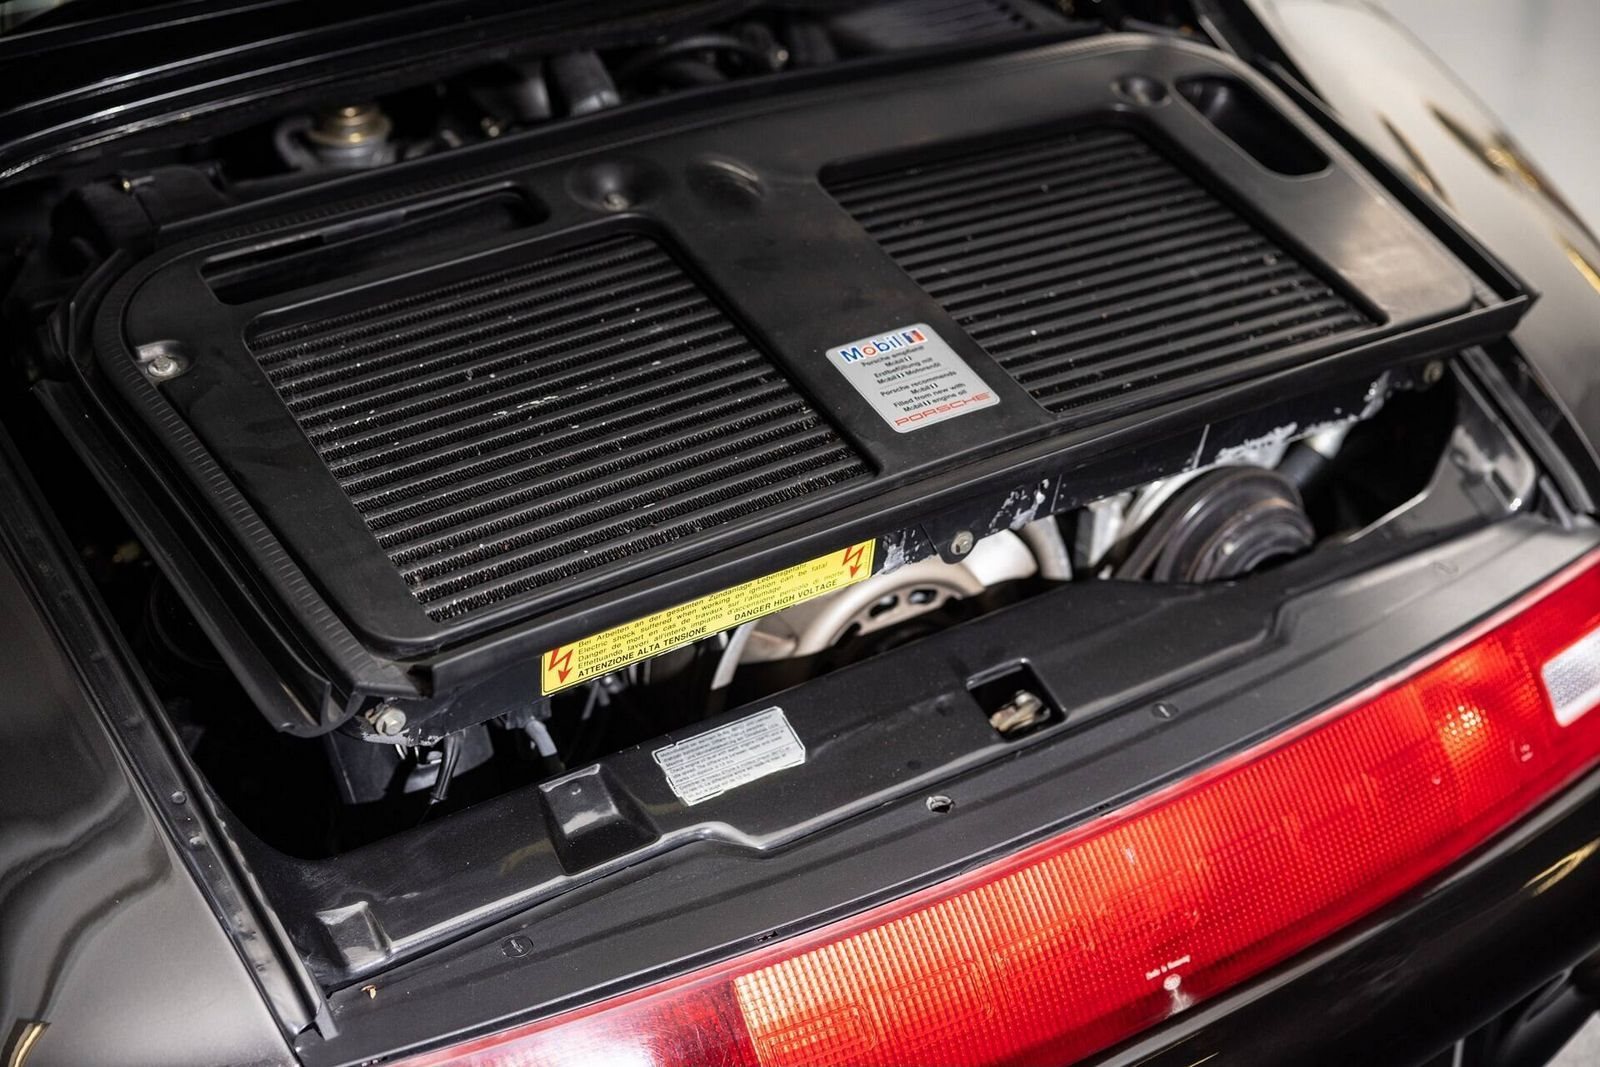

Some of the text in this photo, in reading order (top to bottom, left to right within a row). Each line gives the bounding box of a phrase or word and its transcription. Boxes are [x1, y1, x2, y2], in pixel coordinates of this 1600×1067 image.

[840, 336, 902, 362] Mobil
[861, 356, 890, 367] Porsche
[885, 358, 904, 367] Mobil
[877, 375, 897, 384] Mobil
[880, 371, 957, 397] Porsche recommends
[910, 385, 931, 394] Mobil
[893, 398, 914, 407] Filled
[914, 393, 932, 401] from
[894, 393, 990, 426] PORSCHE
[903, 403, 923, 412] Mobil
[932, 393, 957, 403] engine
[578, 641, 607, 655] Electric
[613, 631, 635, 643] shock
[640, 617, 672, 633] suffered
[676, 609, 696, 620] when
[701, 597, 730, 611] working
[749, 581, 775, 594] ignition
[780, 575, 793, 583] can
[811, 562, 827, 571] fatal
[578, 640, 591, 648] Bei
[596, 626, 629, 641] Arbeiten
[648, 614, 662, 623] der
[666, 600, 703, 618] gesamten
[578, 579, 837, 678] ATTENZIONE ALTA TENSIONE DANGER HIGH VOLTAGE
[578, 648, 606, 662] Danger
[626, 634, 644, 644] mort
[695, 607, 722, 620] travaux
[728, 600, 739, 608] sur
[578, 649, 623, 669] Effettuando
[627, 640, 648, 651] lavori
[654, 626, 686, 642] all'intero
[690, 613, 722, 628] impianto
[727, 595, 774, 616] d'accensione
